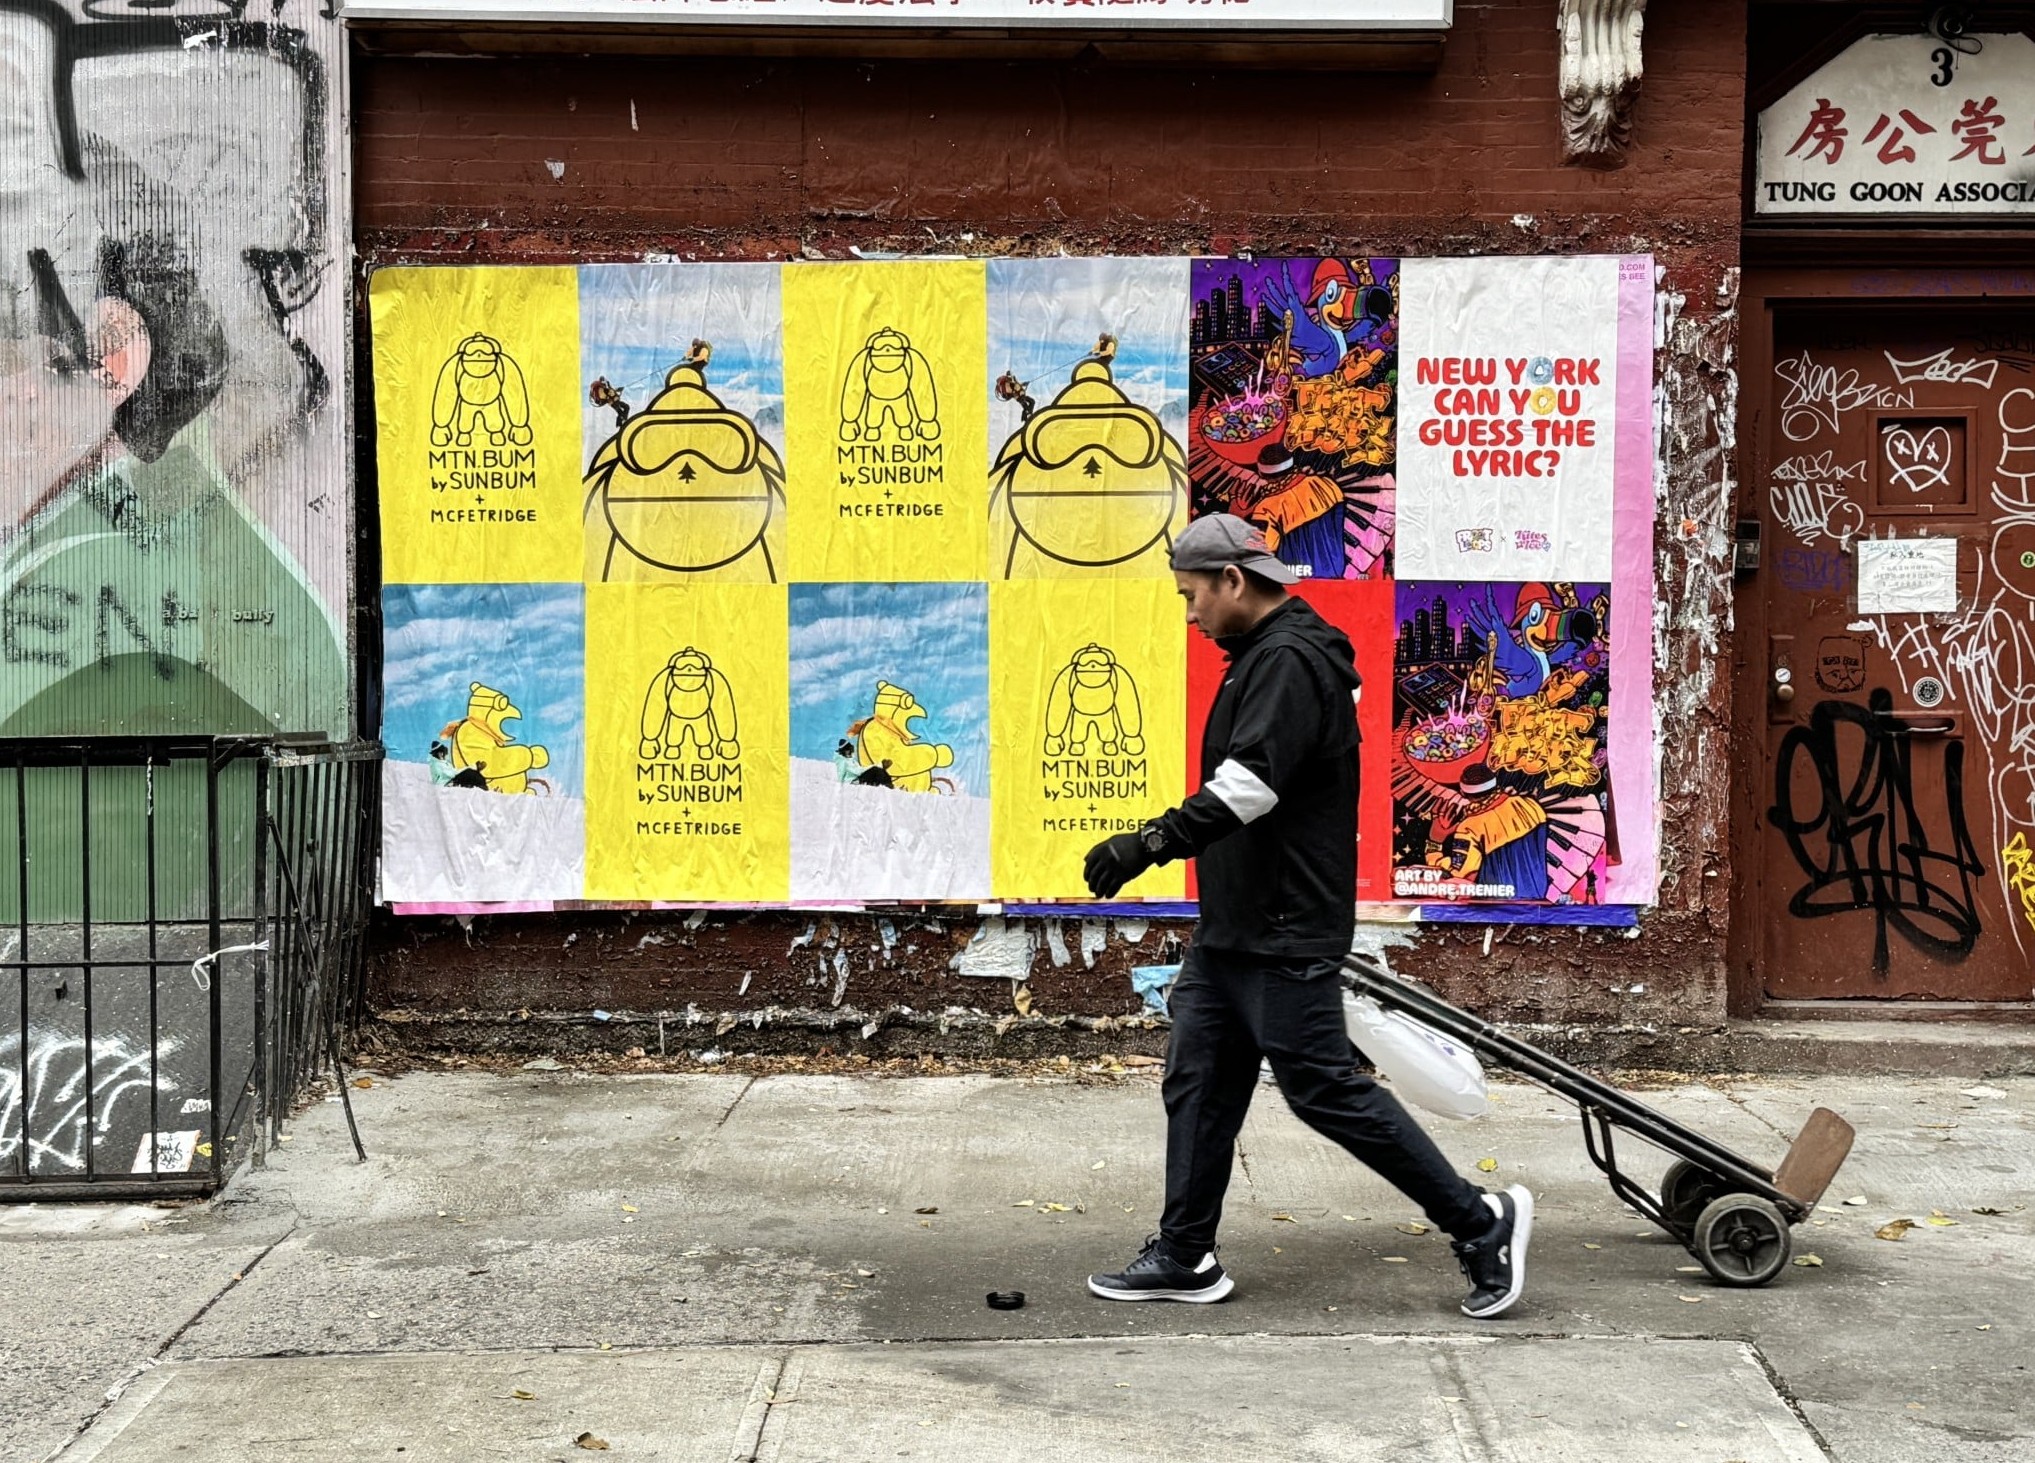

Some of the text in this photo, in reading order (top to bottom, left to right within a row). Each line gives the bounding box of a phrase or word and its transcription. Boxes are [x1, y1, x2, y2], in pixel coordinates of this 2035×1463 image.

[1930, 47, 1953, 87] 3
[1764, 182, 1836, 202] TUNG
[1850, 182, 1924, 202] GOON
[1417, 356, 1600, 386] NEW YORK
[1434, 386, 1581, 416] CAN YOU
[1418, 419, 1596, 447] GUESS THE
[1452, 449, 1560, 477] LYRIC?
[431, 476, 447, 493] by
[840, 471, 855, 487] by
[431, 509, 537, 523] MCFETRIDGE
[839, 504, 944, 518] MCFETRIDGE
[231, 608, 274, 625] bully
[638, 788, 655, 805] by
[1044, 785, 1060, 802] by
[637, 821, 742, 835] MCFETRIDGE
[1395, 869, 1442, 881] ART BY
